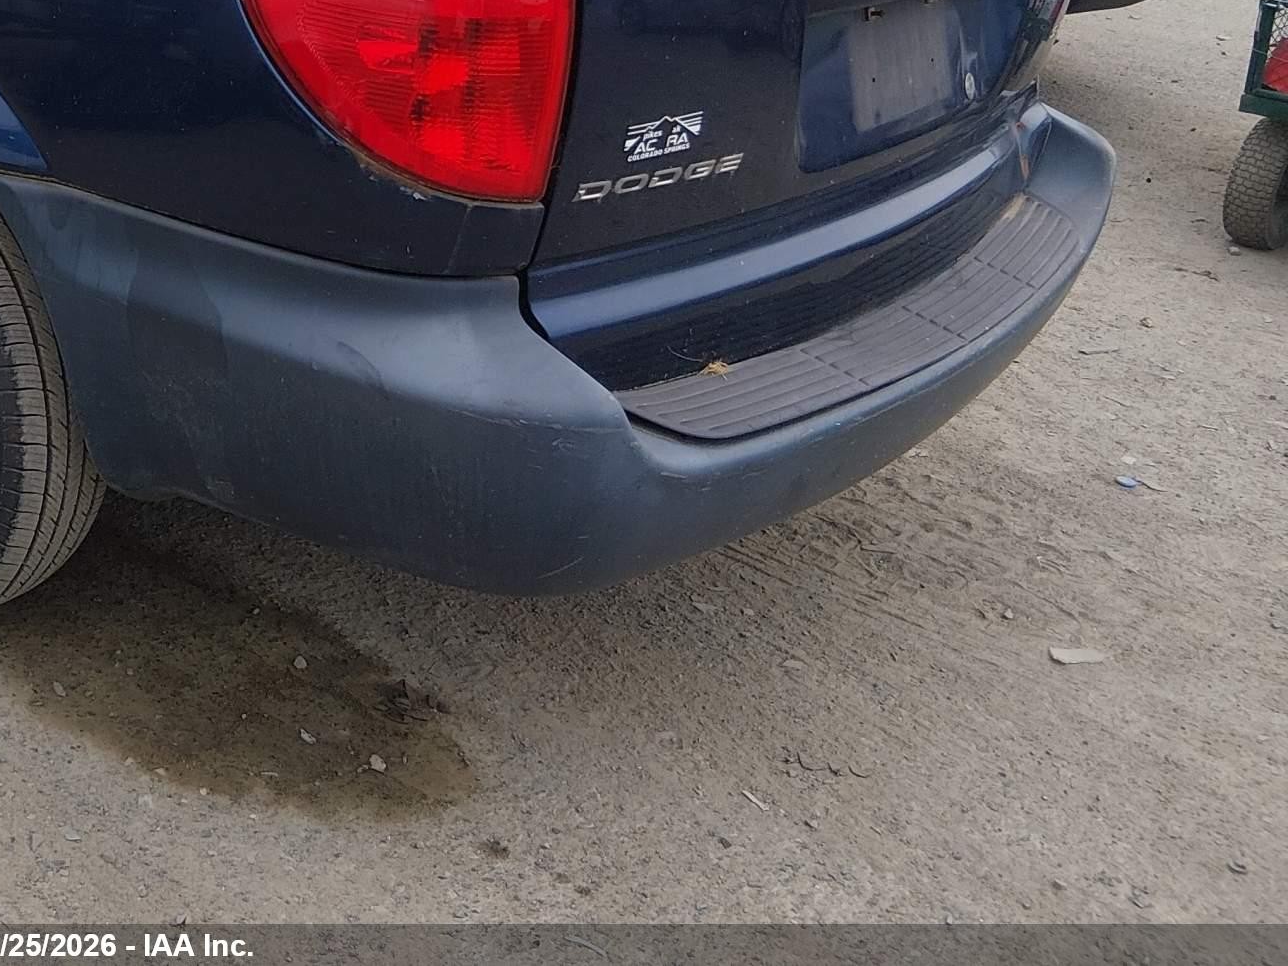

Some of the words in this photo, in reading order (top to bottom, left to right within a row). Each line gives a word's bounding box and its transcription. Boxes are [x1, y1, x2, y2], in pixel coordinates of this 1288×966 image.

[627, 149, 664, 163] COLORADO
[663, 142, 691, 155] SPRINGS
[570, 152, 744, 202] DODGE
